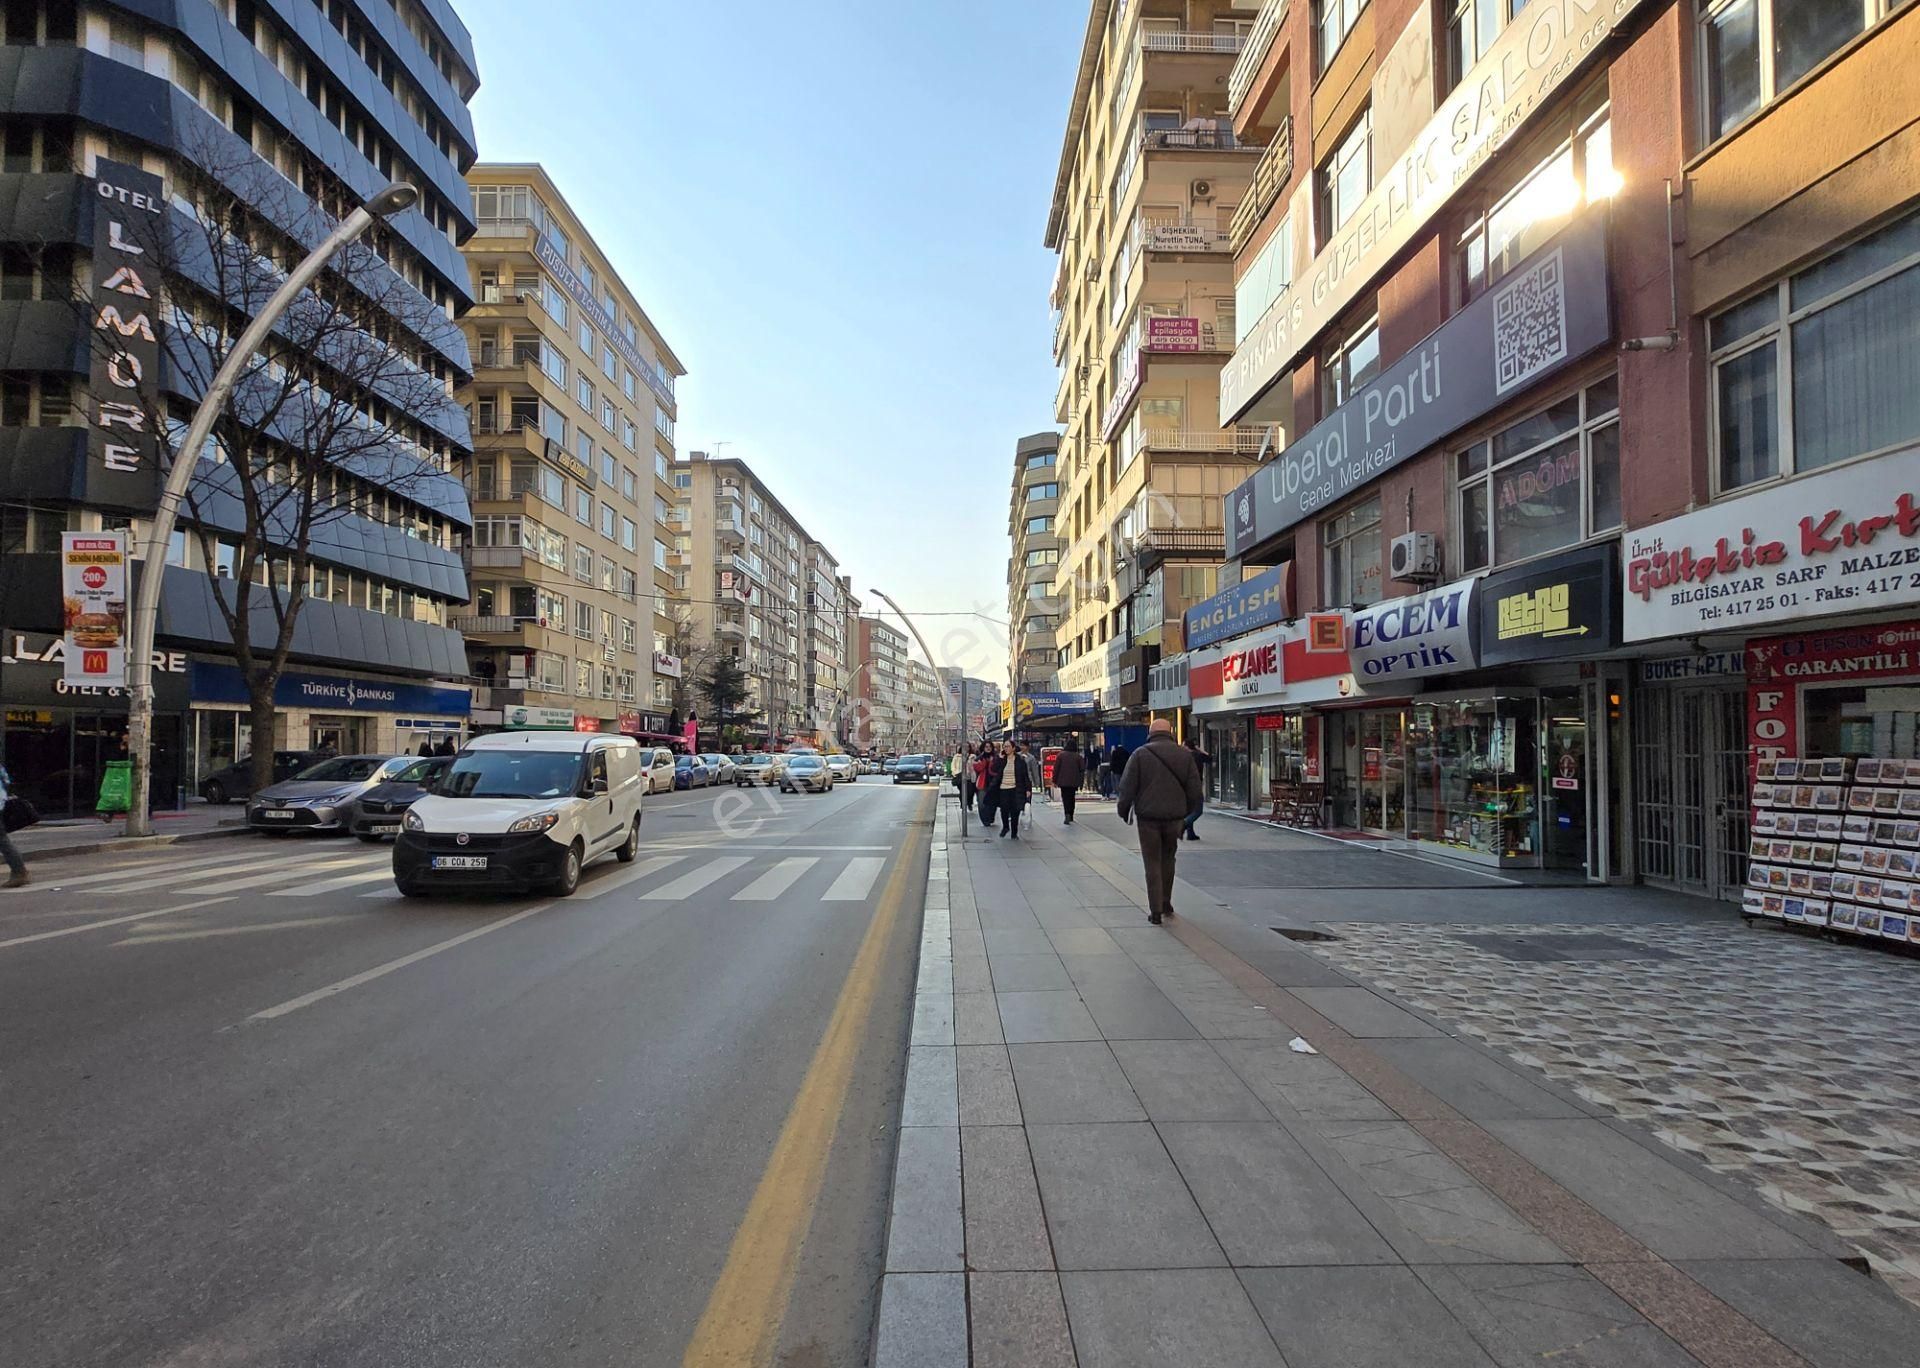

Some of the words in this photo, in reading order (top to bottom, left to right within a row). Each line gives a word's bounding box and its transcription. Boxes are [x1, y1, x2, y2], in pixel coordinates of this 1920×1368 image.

[98, 181, 160, 214] OTEL
[1184, 236, 1204, 244] TUNA
[541, 241, 577, 292] PUSULA
[1154, 327, 1193, 336] epilasyon
[1271, 411, 1349, 505] Liberal
[1363, 340, 1441, 444] Parti
[1299, 479, 1335, 512] Genel
[1339, 434, 1396, 490] Merkezi
[1629, 527, 1788, 602] Gültekin
[1632, 537, 1664, 559] Ümit
[83, 572, 101, 583] 200
[1671, 576, 1765, 606] BİLGİSAYAR
[1776, 564, 1828, 587] SARF
[1190, 583, 1280, 634] ENGLISH
[1498, 583, 1569, 632] RETRO
[1699, 605, 1722, 621] Tel:
[1725, 599, 1752, 616] 417
[1757, 594, 1775, 612] 25
[1780, 592, 1799, 608] 01
[1815, 585, 1860, 602] Faks:
[1866, 575, 1904, 594] 417
[1353, 590, 1464, 650] ECEM
[1222, 642, 1278, 683] ECZANE
[1363, 642, 1458, 675] OPTİK
[1645, 657, 1690, 680] BUKET
[1784, 649, 1909, 677] GARANTİLİ
[301, 681, 346, 698] TÜRKİYE
[356, 688, 395, 701] BANKASI
[1241, 680, 1259, 695] ÜLKÜ
[437, 857, 447, 867] 06
[470, 857, 486, 867] 259
